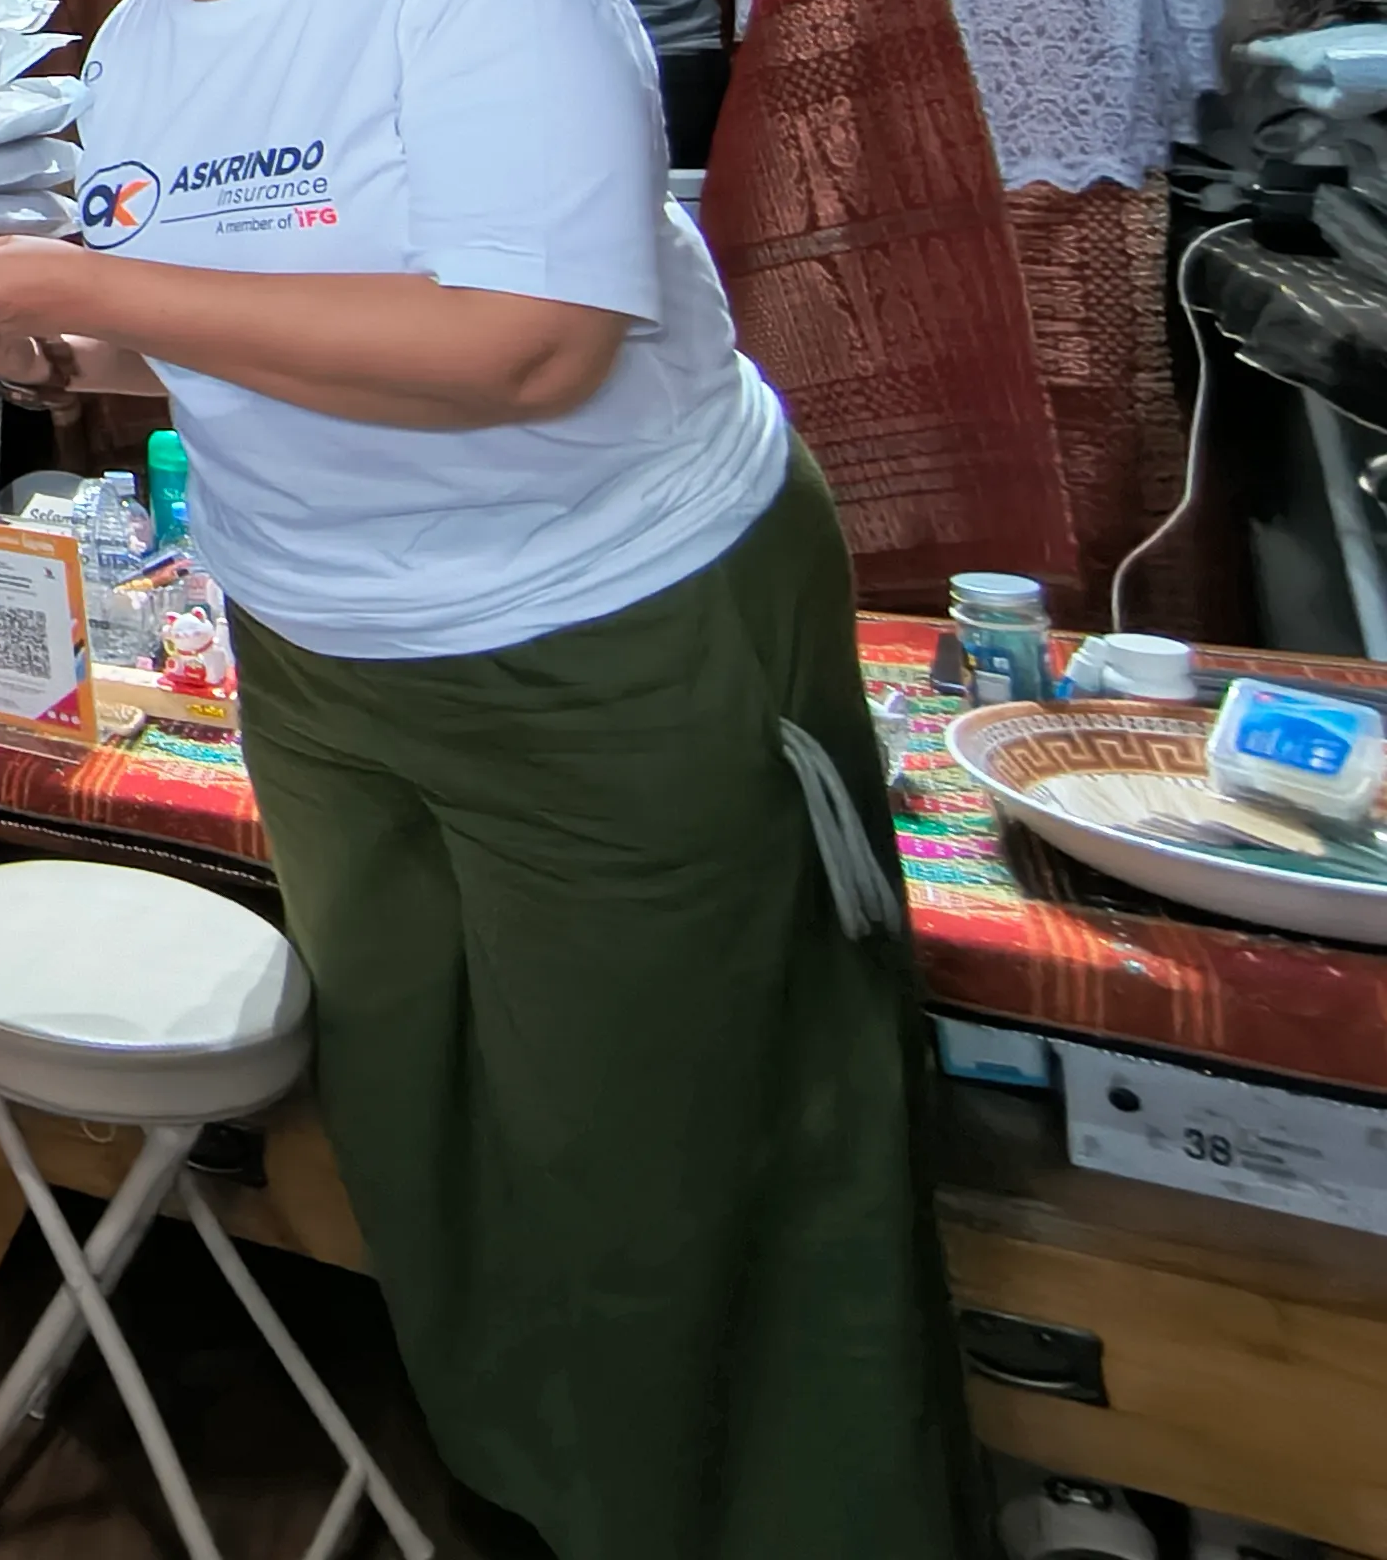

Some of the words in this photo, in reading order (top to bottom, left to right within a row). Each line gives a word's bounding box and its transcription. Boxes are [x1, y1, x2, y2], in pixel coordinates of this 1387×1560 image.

[169, 140, 324, 195] ASKRINDO
[226, 217, 274, 233] member
[277, 213, 292, 230] of
[1183, 1128, 1232, 1168] 38
